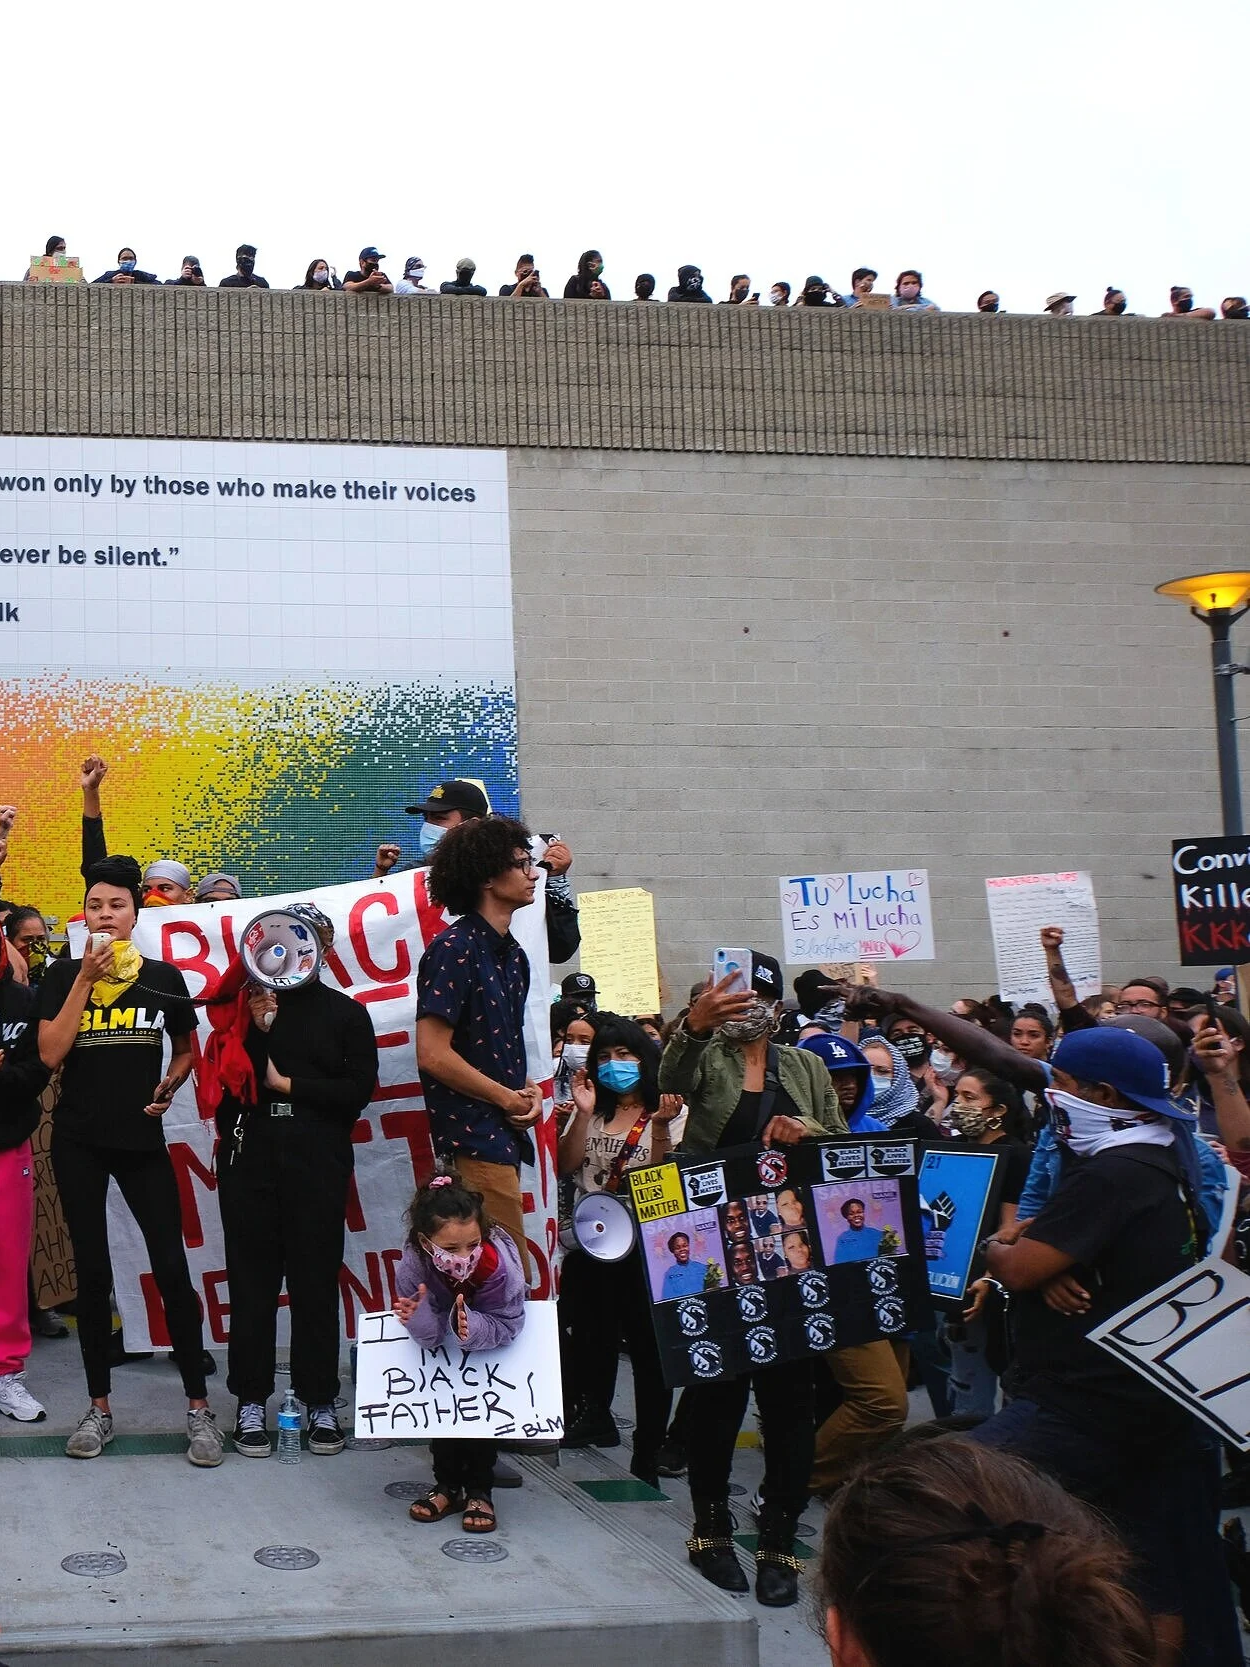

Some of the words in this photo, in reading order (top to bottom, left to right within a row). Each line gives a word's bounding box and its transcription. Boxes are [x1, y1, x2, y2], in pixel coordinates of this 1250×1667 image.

[53, 473, 103, 498] only
[110, 474, 137, 498] by
[142, 475, 210, 496] those
[216, 477, 265, 497] who
[273, 479, 337, 499] make
[342, 480, 397, 500] their
[404, 481, 476, 503] voices
[58, 544, 87, 565] be
[94, 545, 179, 567] silent.”
[847, 874, 915, 905] Lucha
[865, 904, 922, 931] Lucha
[161, 872, 451, 1001] BLCK
[1181, 921, 1250, 953] KKK
[828, 1042, 848, 1058] LA
[926, 1156, 942, 1169] 21
[631, 1169, 664, 1186] BLACK
[818, 1185, 854, 1199] SAY
[863, 1179, 896, 1193] HER
[636, 1185, 664, 1203] LIVES
[639, 1200, 680, 1219] MATTER
[361, 1313, 410, 1344] I
[358, 1390, 515, 1434] FATHER
